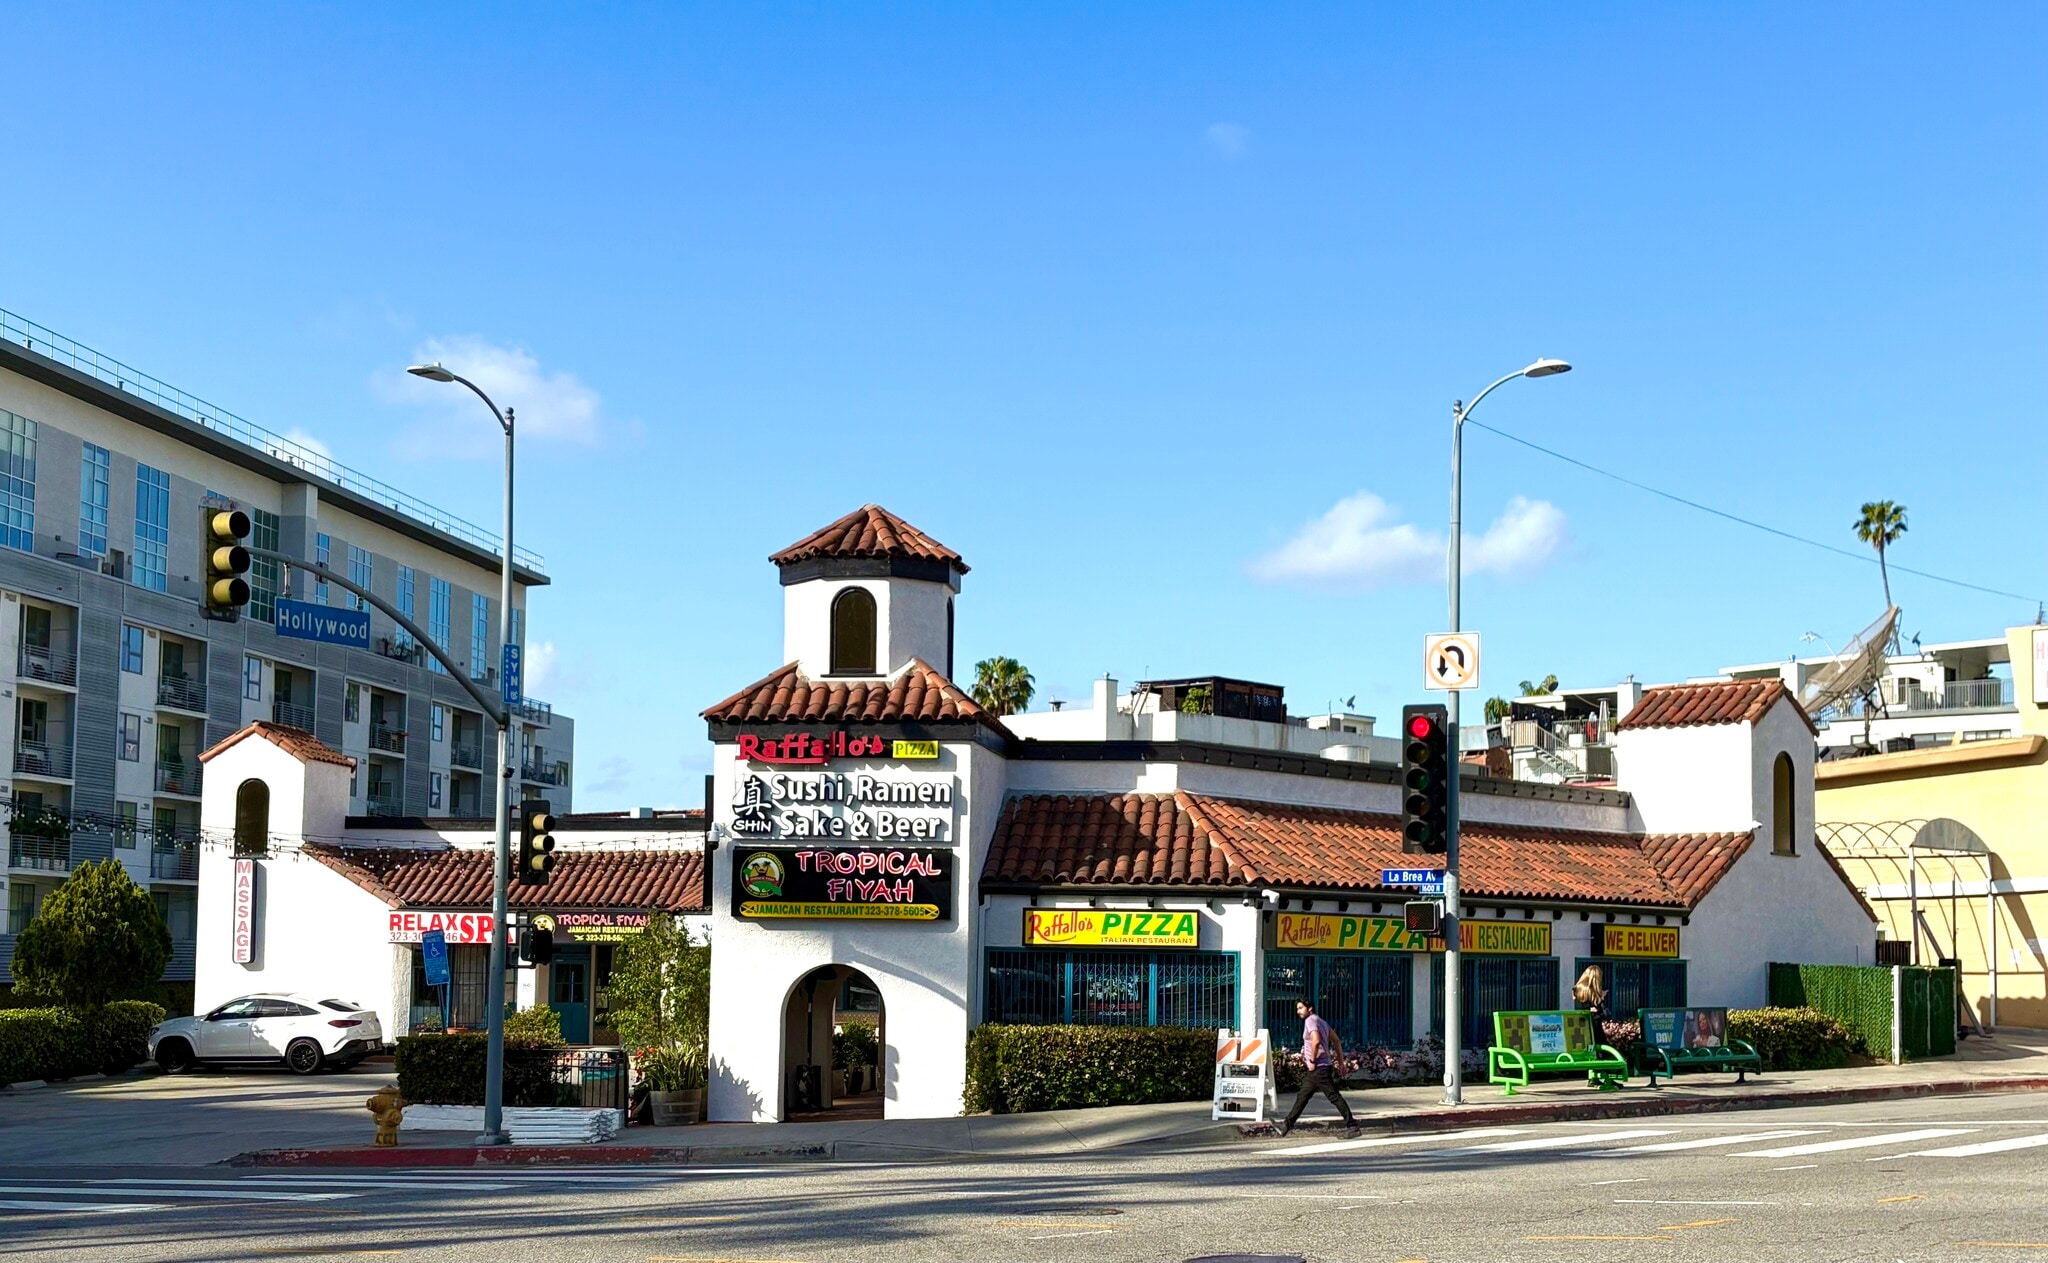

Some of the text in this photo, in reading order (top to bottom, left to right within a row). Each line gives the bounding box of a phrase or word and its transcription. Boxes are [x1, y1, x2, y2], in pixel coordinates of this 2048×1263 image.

[278, 605, 367, 641] Hollywood
[736, 731, 883, 764] Raffallo's
[895, 743, 936, 757] PIZZA
[733, 776, 772, 819] 真
[770, 773, 951, 806] Sushi, Ramen
[733, 819, 772, 832] SHIN
[779, 810, 942, 838] Sake & Beer
[795, 851, 942, 877] TROPICAL
[1389, 871, 1399, 882] La
[1403, 871, 1423, 882] Brea
[827, 878, 914, 903] FIYAH
[236, 861, 251, 961] MASSAGE
[389, 914, 458, 931] RELAX
[556, 914, 614, 926] TROPICAL
[754, 903, 925, 916] JAMAICAN RESTAURANT 323-378-5605
[567, 926, 645, 934] JAMAICAN RESTAURANT
[1028, 910, 1194, 943] Raffallo's PIZZA
[1280, 915, 1331, 946] Raffallo's
[1478, 924, 1548, 951] RESTAURANT
[1605, 929, 1676, 953] WE DELIVER
